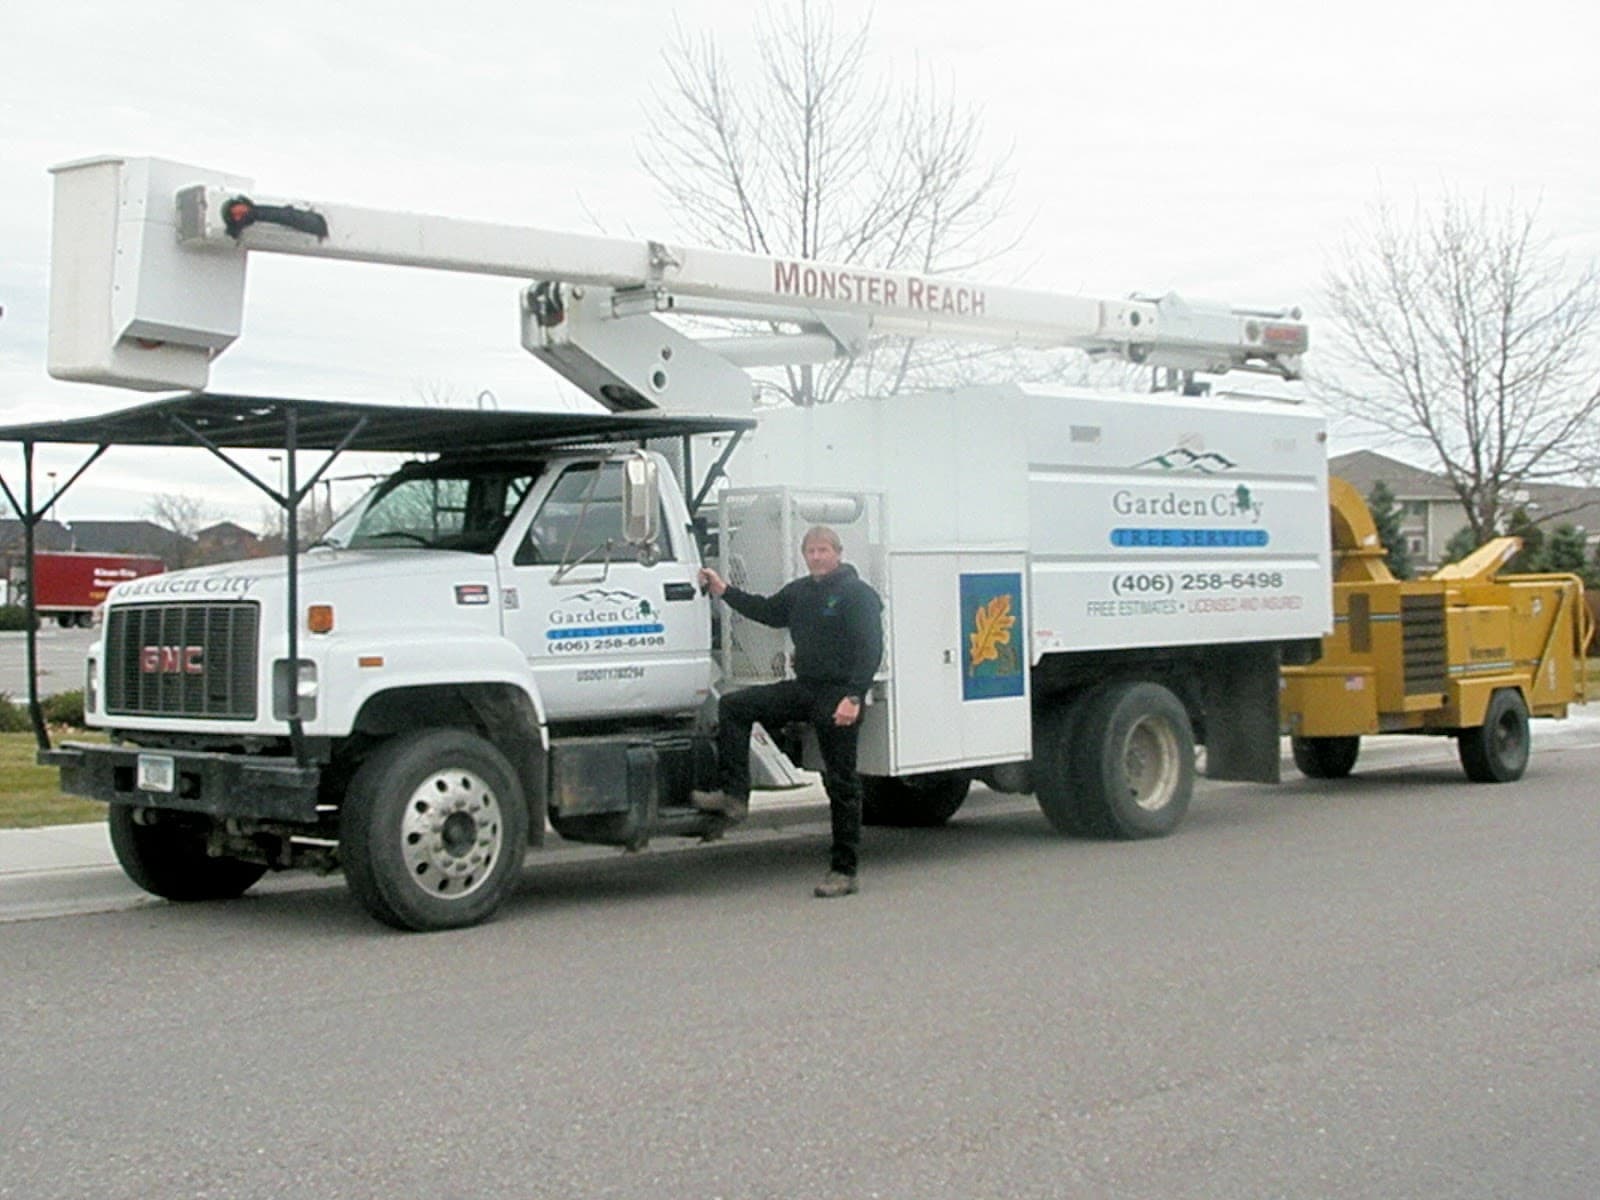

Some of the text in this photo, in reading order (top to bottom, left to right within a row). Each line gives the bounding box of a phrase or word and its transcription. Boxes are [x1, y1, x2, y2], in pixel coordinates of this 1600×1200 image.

[1115, 529, 1267, 547] TREE SERVICE
[1112, 572, 1284, 596] (406) 258-6498
[1087, 600, 1117, 616] FREE
[547, 641, 590, 654] (406)
[140, 645, 204, 674] GMC
